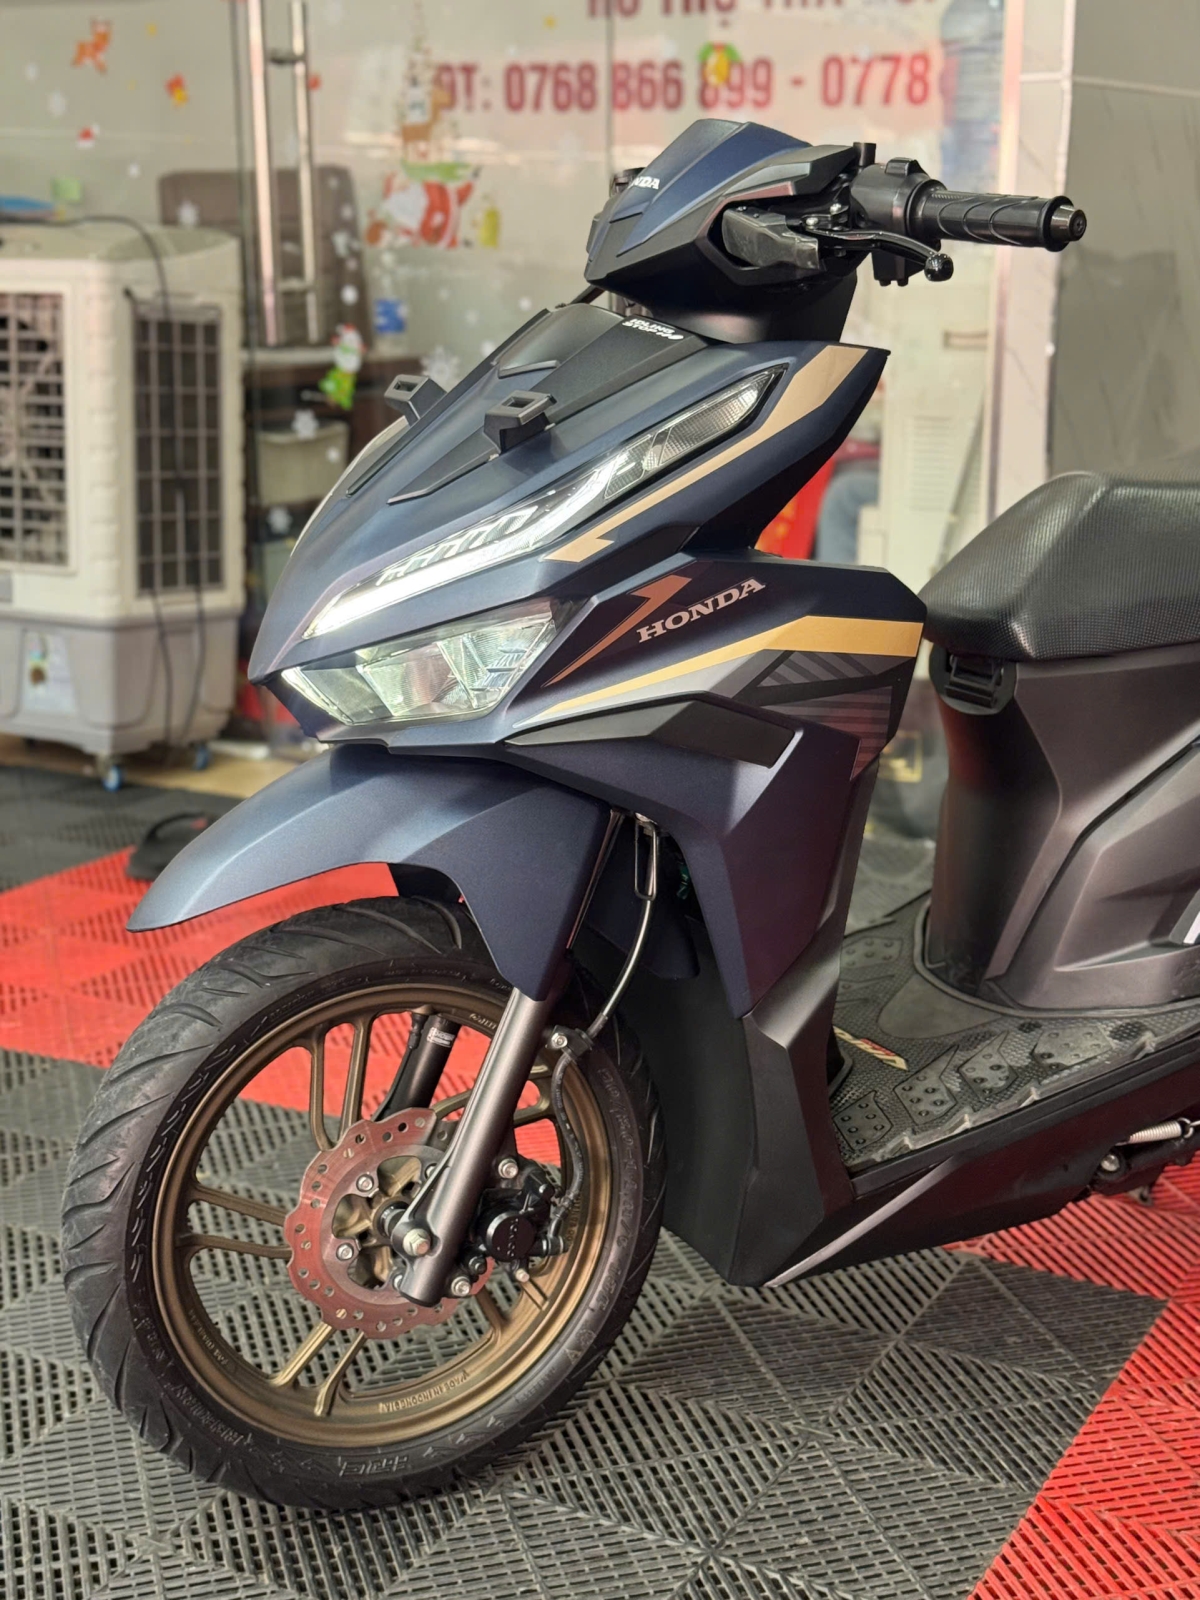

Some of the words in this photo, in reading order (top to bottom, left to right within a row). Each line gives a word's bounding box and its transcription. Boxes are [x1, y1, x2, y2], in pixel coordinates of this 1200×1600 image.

[504, 62, 598, 112] 0768
[612, 60, 684, 111] 866
[821, 53, 930, 107] 0778
[636, 578, 766, 643] HONDA
